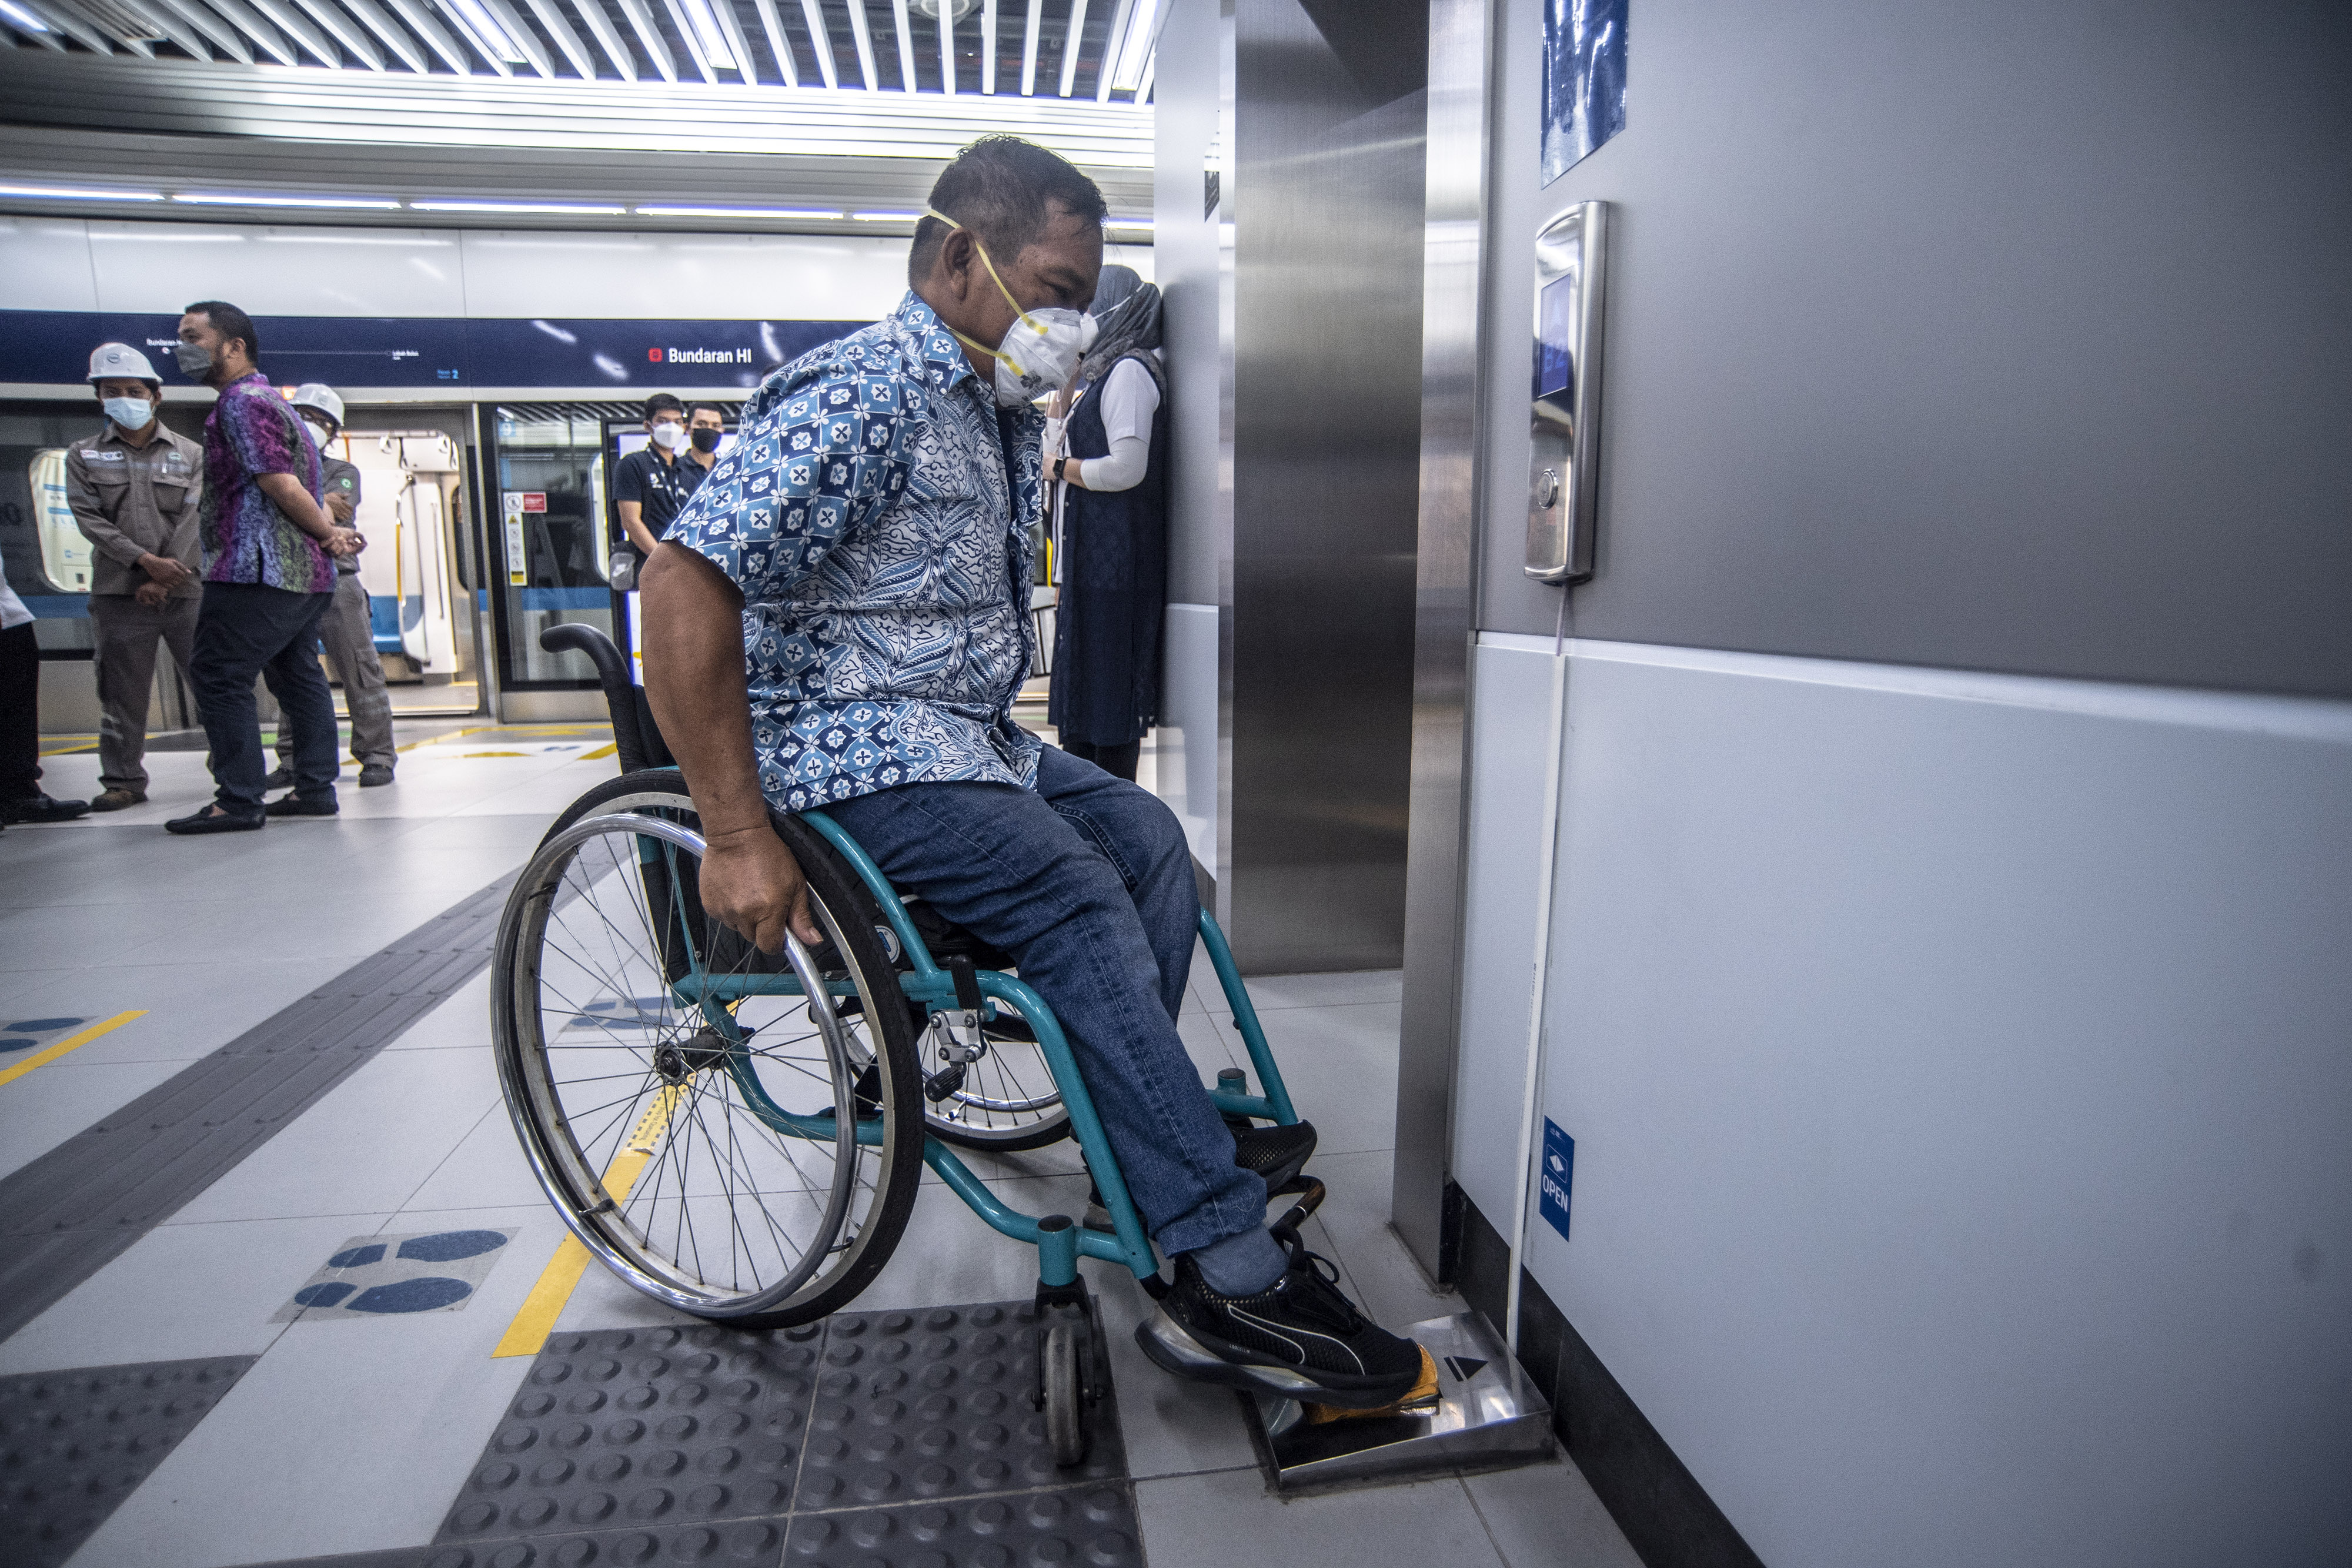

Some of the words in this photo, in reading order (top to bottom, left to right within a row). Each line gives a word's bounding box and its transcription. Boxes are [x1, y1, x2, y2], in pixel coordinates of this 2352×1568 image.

[668, 347, 733, 363] Bundaran
[736, 347, 752, 363] HI
[452, 369, 459, 379] 2
[1542, 1174, 1568, 1213] OPEN
